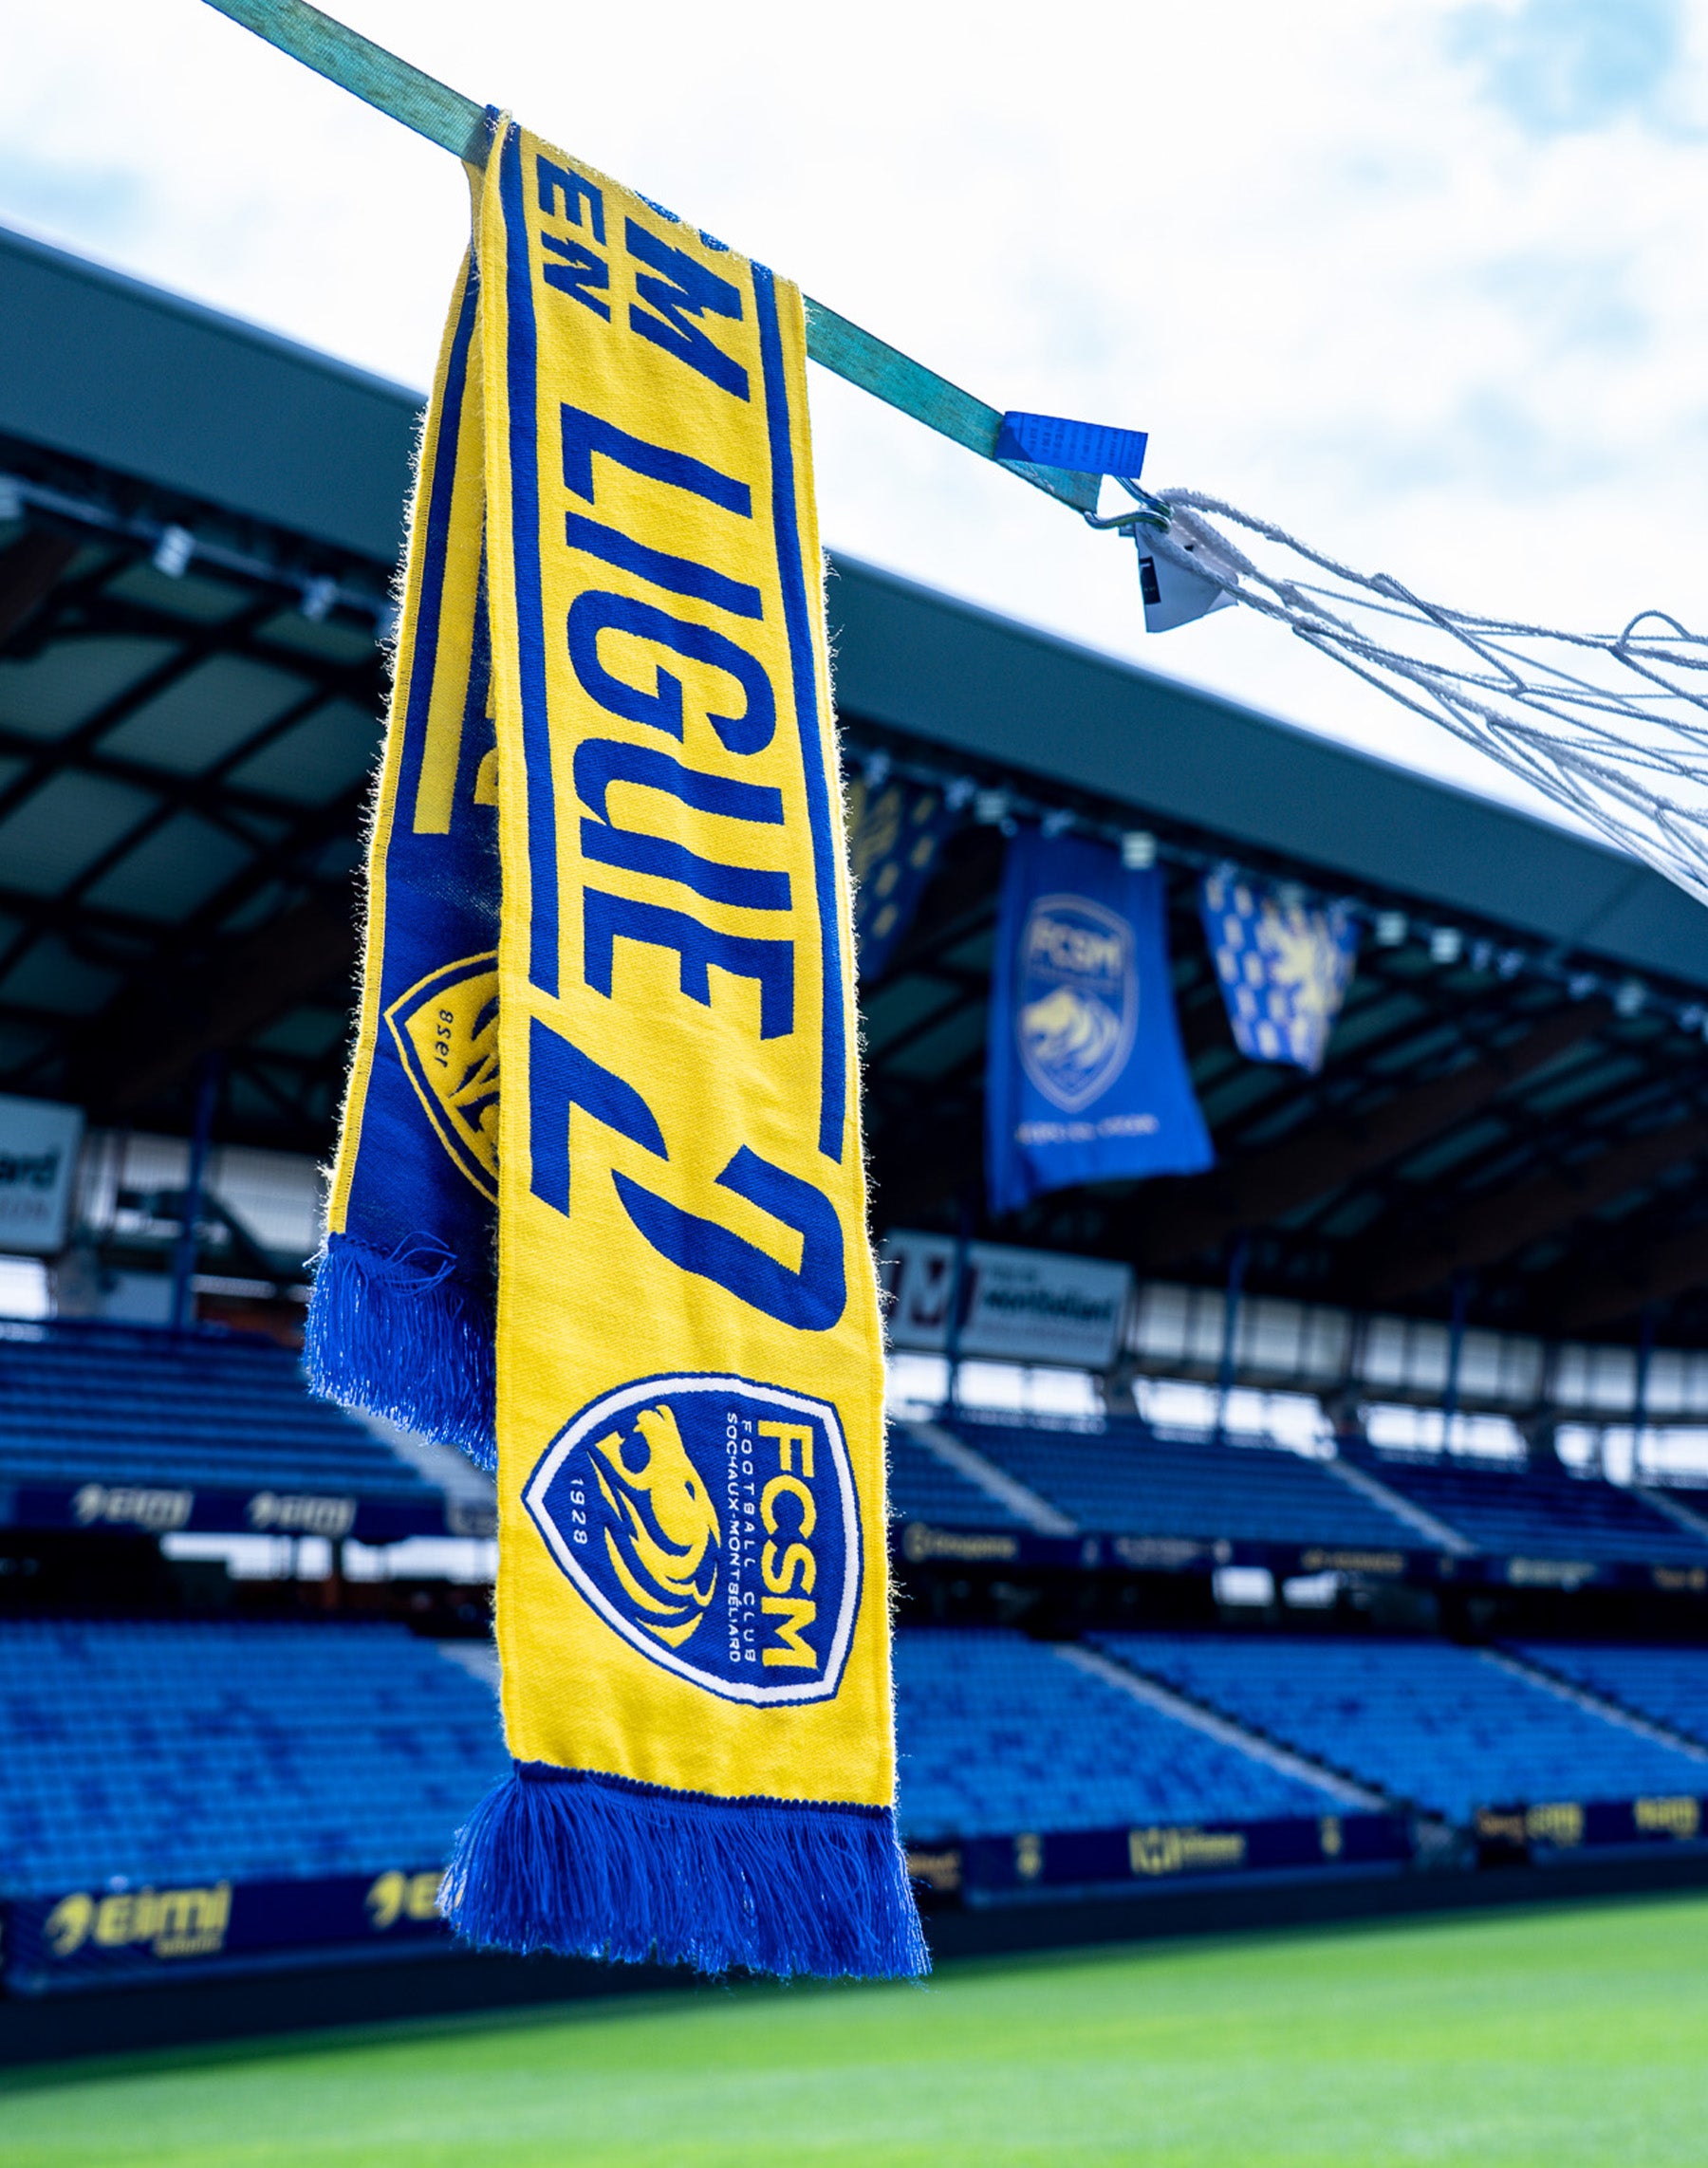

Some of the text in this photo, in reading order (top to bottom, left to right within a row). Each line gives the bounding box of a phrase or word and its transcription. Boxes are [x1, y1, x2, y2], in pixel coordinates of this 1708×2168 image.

[536, 154, 611, 323] EN
[625, 216, 751, 402] M
[529, 402, 847, 1332] LIGUE 2
[570, 1477, 588, 1545] 1928
[726, 1412, 742, 1662] SOCHAUX-MONTBÉLIARD
[741, 1418, 757, 1662] FOOTBALL CLUB
[758, 1419, 819, 1670] FCSM
